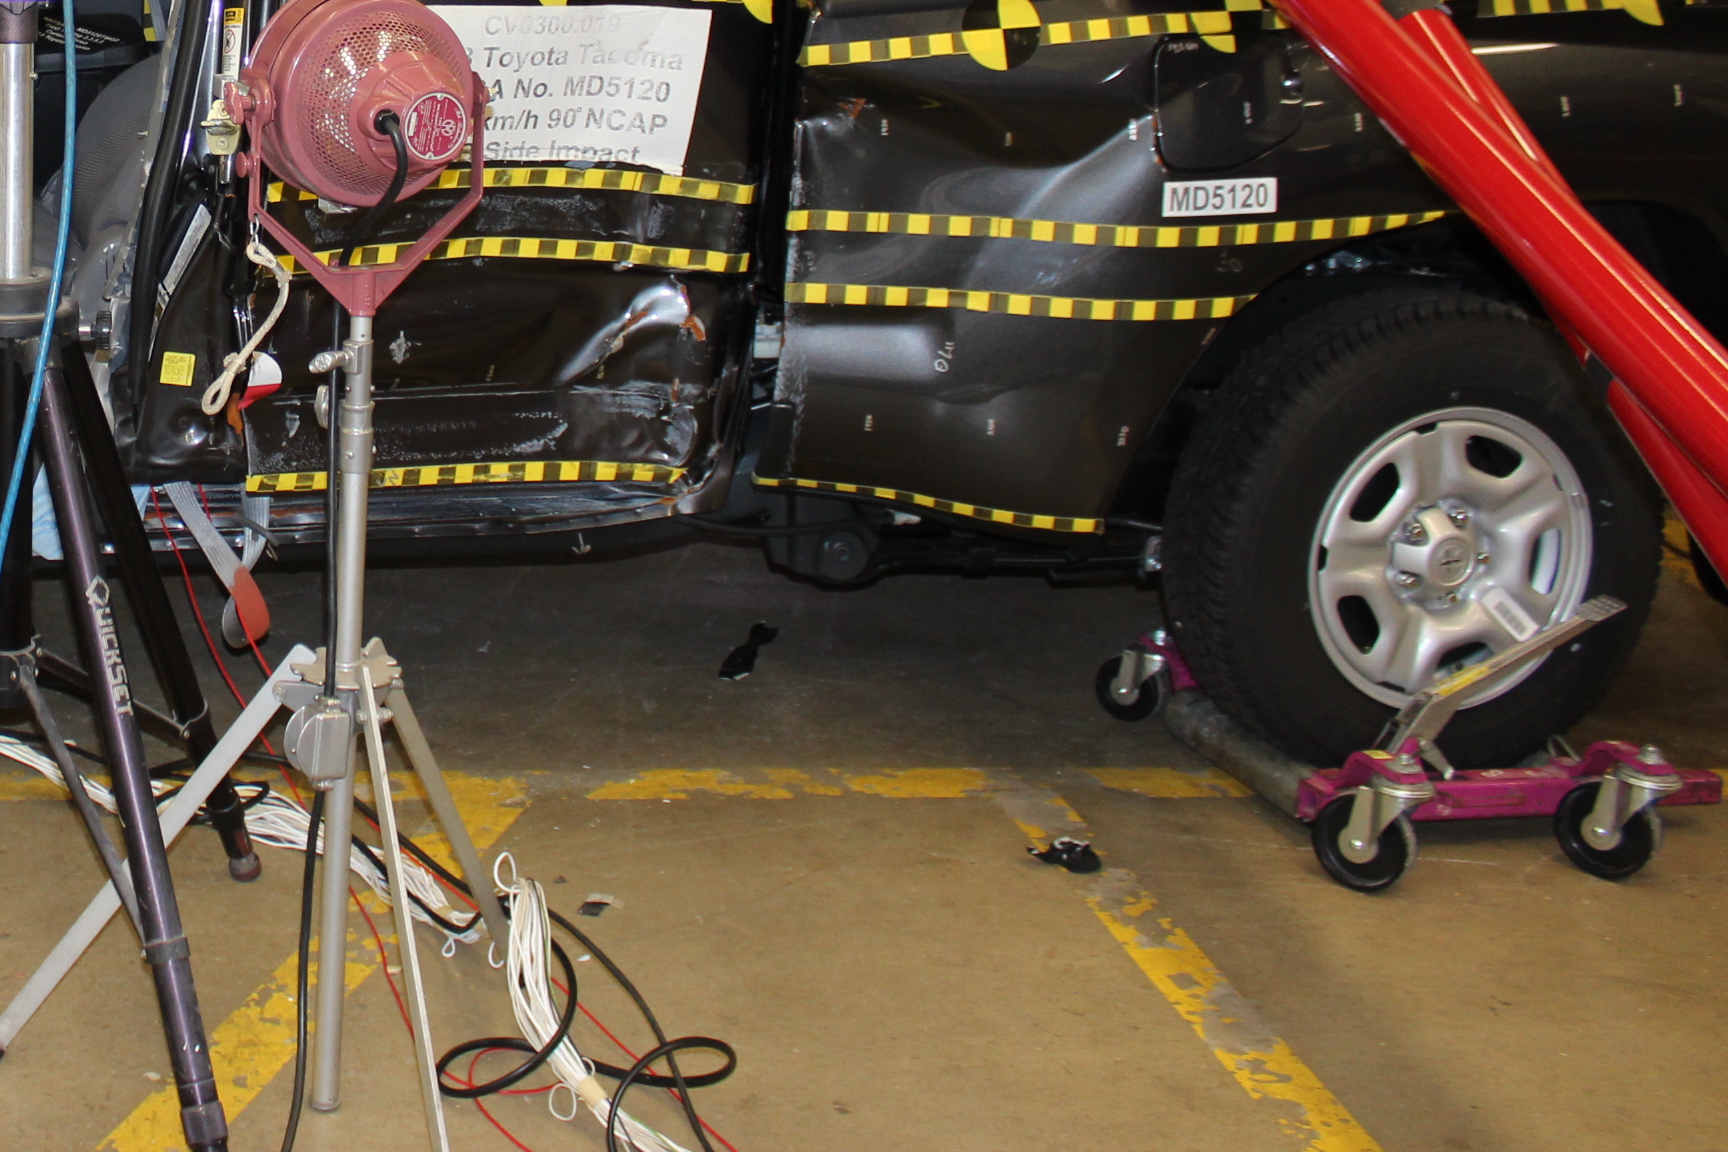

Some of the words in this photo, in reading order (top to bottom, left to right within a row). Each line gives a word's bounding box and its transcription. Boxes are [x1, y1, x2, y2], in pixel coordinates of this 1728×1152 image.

[484, 46, 569, 73] Toyota
[579, 42, 683, 71] Tacoma
[513, 77, 554, 99] No.
[563, 74, 671, 103] MD5120
[585, 107, 668, 135] NCAP
[484, 140, 540, 160] Side
[1169, 182, 1268, 212] MD5120
[85, 575, 134, 717] QUICKSET
